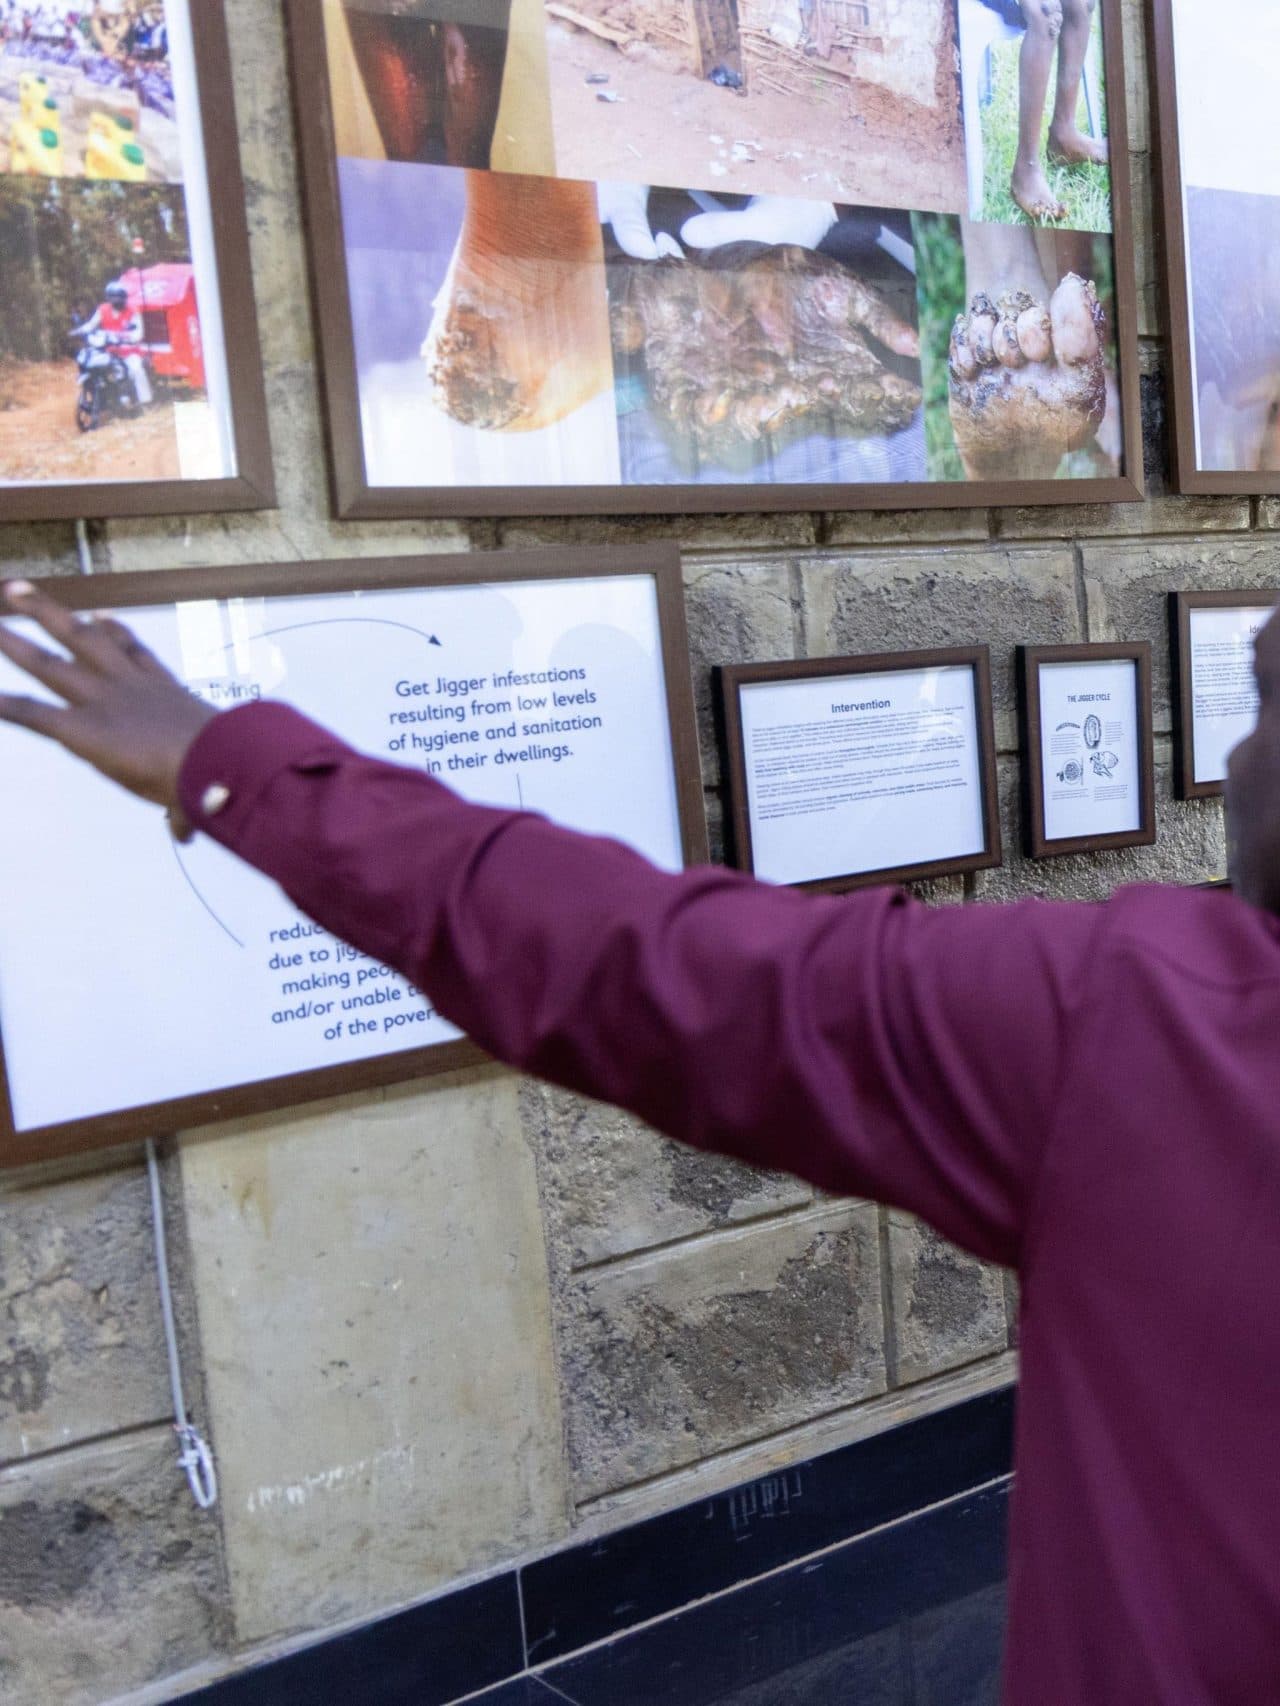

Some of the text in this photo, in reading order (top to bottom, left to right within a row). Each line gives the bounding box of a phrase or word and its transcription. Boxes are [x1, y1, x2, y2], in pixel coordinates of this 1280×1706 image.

[395, 667, 587, 697] Get Jigger infestations
[389, 688, 597, 725] resulting from low levels
[831, 699, 891, 713] Intervention
[388, 715, 603, 752] of hygiene and sanitation
[427, 743, 574, 774] in their dwellings.
[268, 952, 303, 970] due
[309, 949, 329, 963] to
[281, 971, 350, 995] making
[271, 1000, 335, 1024] and/or
[341, 986, 402, 1011] unable
[324, 1021, 342, 1040] of
[348, 1017, 378, 1036] the
